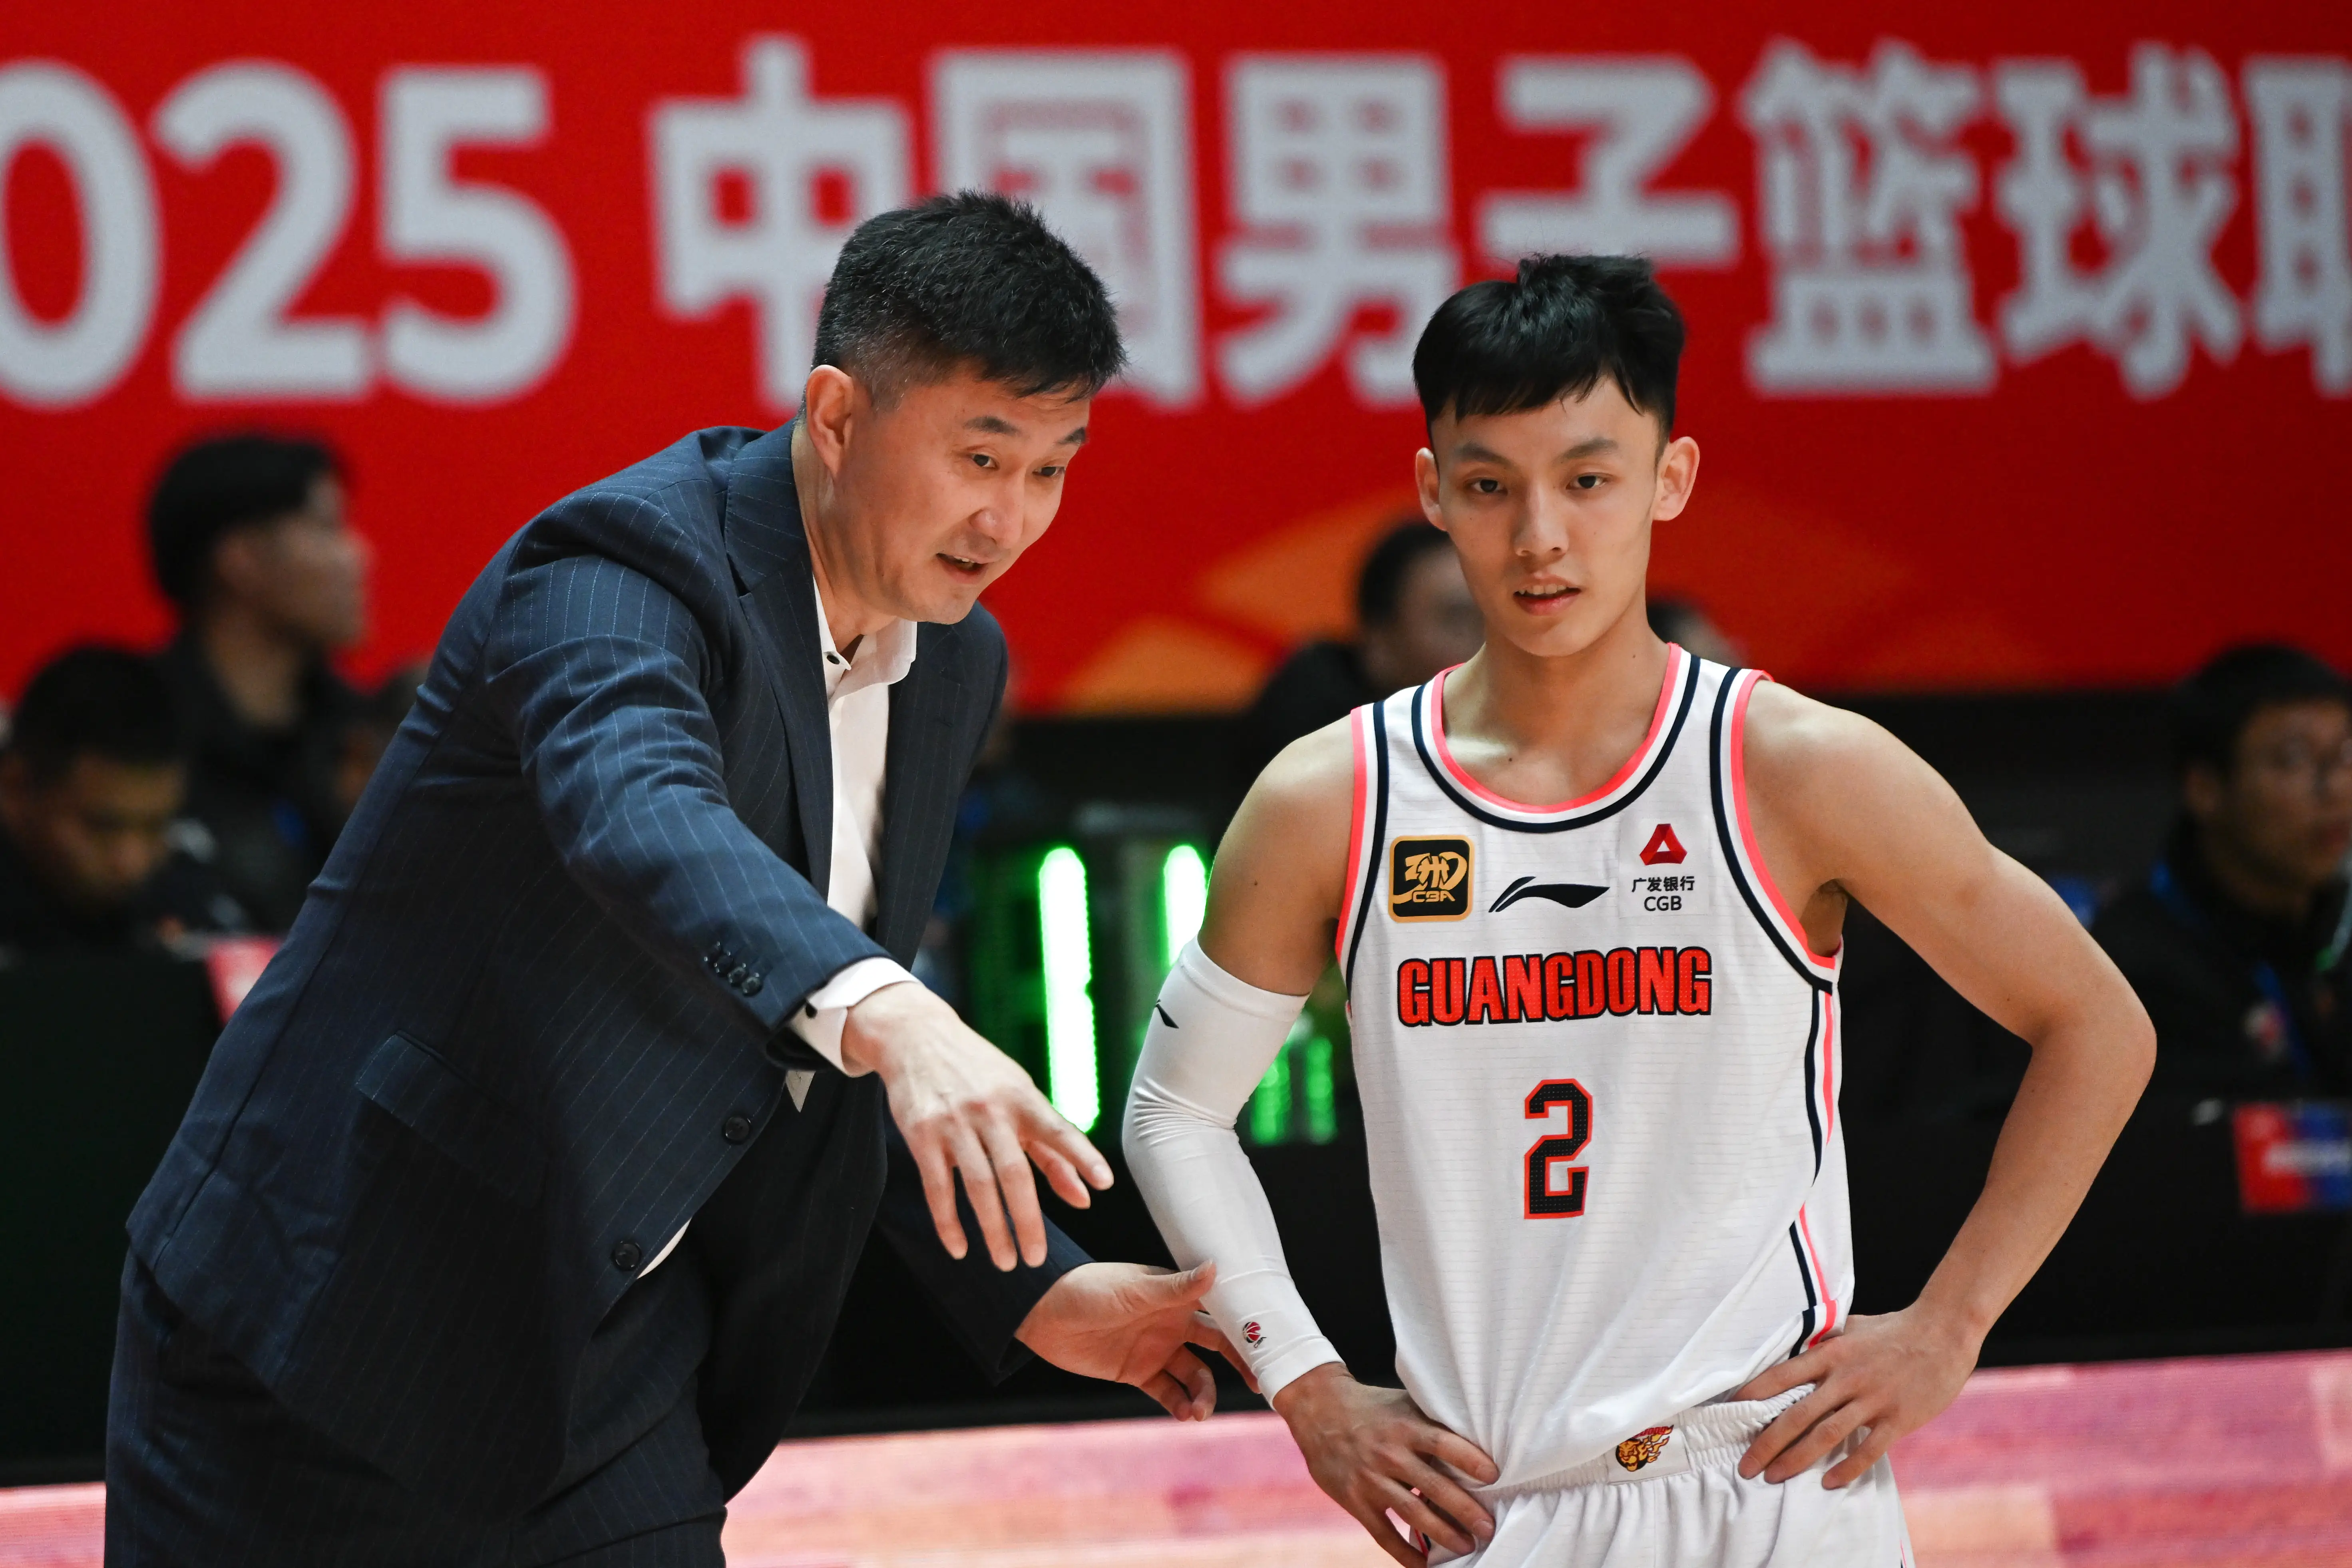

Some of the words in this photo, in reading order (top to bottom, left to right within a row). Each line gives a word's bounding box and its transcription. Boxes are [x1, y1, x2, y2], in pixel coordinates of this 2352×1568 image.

[1632, 876, 1695, 892] 广发银行
[1413, 890, 1456, 903] CBA
[1644, 895, 1682, 911] CGB
[1397, 946, 1712, 1027] GUANGDONG
[1523, 1078, 1593, 1220] 2
